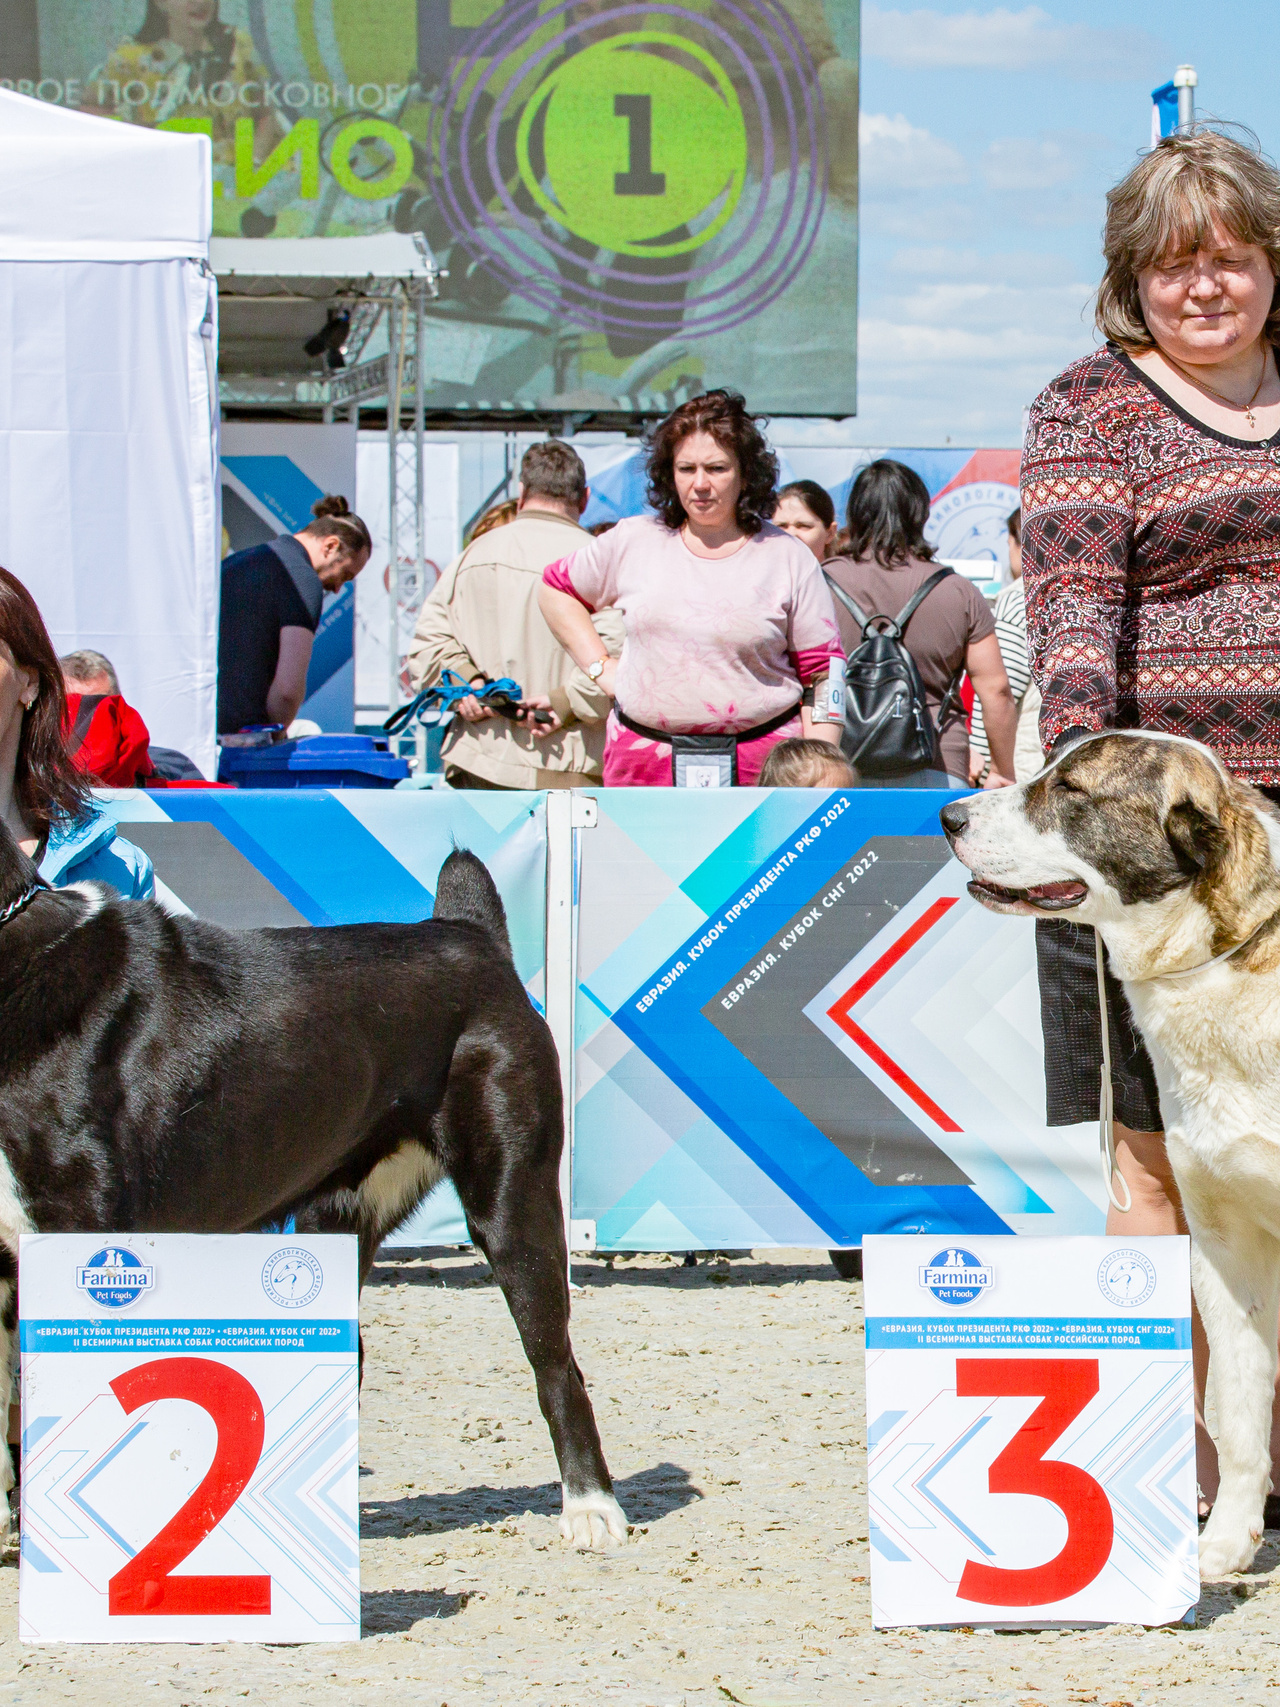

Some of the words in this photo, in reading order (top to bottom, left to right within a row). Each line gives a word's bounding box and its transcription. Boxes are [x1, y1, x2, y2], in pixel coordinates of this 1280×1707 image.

[97, 79, 409, 108] ПОДМОСКОВНОЕ
[613, 95, 666, 195] 1
[635, 961, 690, 1013] ЕВРАЗИЯ.
[688, 920, 727, 960] КУБОК
[725, 851, 798, 923] ПРЕЗИДЕНТА
[794, 826, 821, 853] РКФ
[820, 797, 851, 828] 2022
[720, 952, 782, 1010] ЕВРАЗИЯ.
[779, 907, 823, 951] КУБОК
[822, 881, 846, 908] СНГ
[845, 850, 879, 884] 2022
[81, 1269, 148, 1285] Farmina
[924, 1269, 988, 1284] Farmina
[96, 1291, 108, 1299] Pet
[110, 1291, 132, 1299] Foods
[939, 1289, 951, 1298] Pet
[952, 1289, 973, 1298] Foods
[83, 1327, 112, 1336] КУБОК
[114, 1327, 170, 1337] ПРЕЗИДЕНТА
[172, 1327, 191, 1336] РКФ
[270, 1327, 298, 1336] КУБОК
[301, 1327, 317, 1336] СНГ
[927, 1325, 955, 1333] КУБОК
[957, 1325, 1010, 1334] ПРЕЗИДЕНТА
[1013, 1325, 1030, 1333] РКФ
[1106, 1325, 1134, 1334] КУБОК
[1136, 1326, 1152, 1334] СНГ
[82, 1338, 134, 1347] ВСЕМИРНАЯ
[136, 1338, 182, 1347] ВЫСТАВКА
[184, 1338, 212, 1347] СОБАК
[215, 1337, 272, 1347] РОССИЙСКИХ
[274, 1338, 305, 1347] ПОРОД
[926, 1335, 976, 1343] ВСЕМИРНАЯ
[979, 1335, 1022, 1343] ВЫСТАВКА
[1024, 1335, 1052, 1343] СОБАК
[1054, 1334, 1109, 1344] РОССИЙСКИХ
[1111, 1336, 1141, 1344] ПОРОД
[109, 1357, 271, 1616] 2
[956, 1358, 1115, 1607] 3
